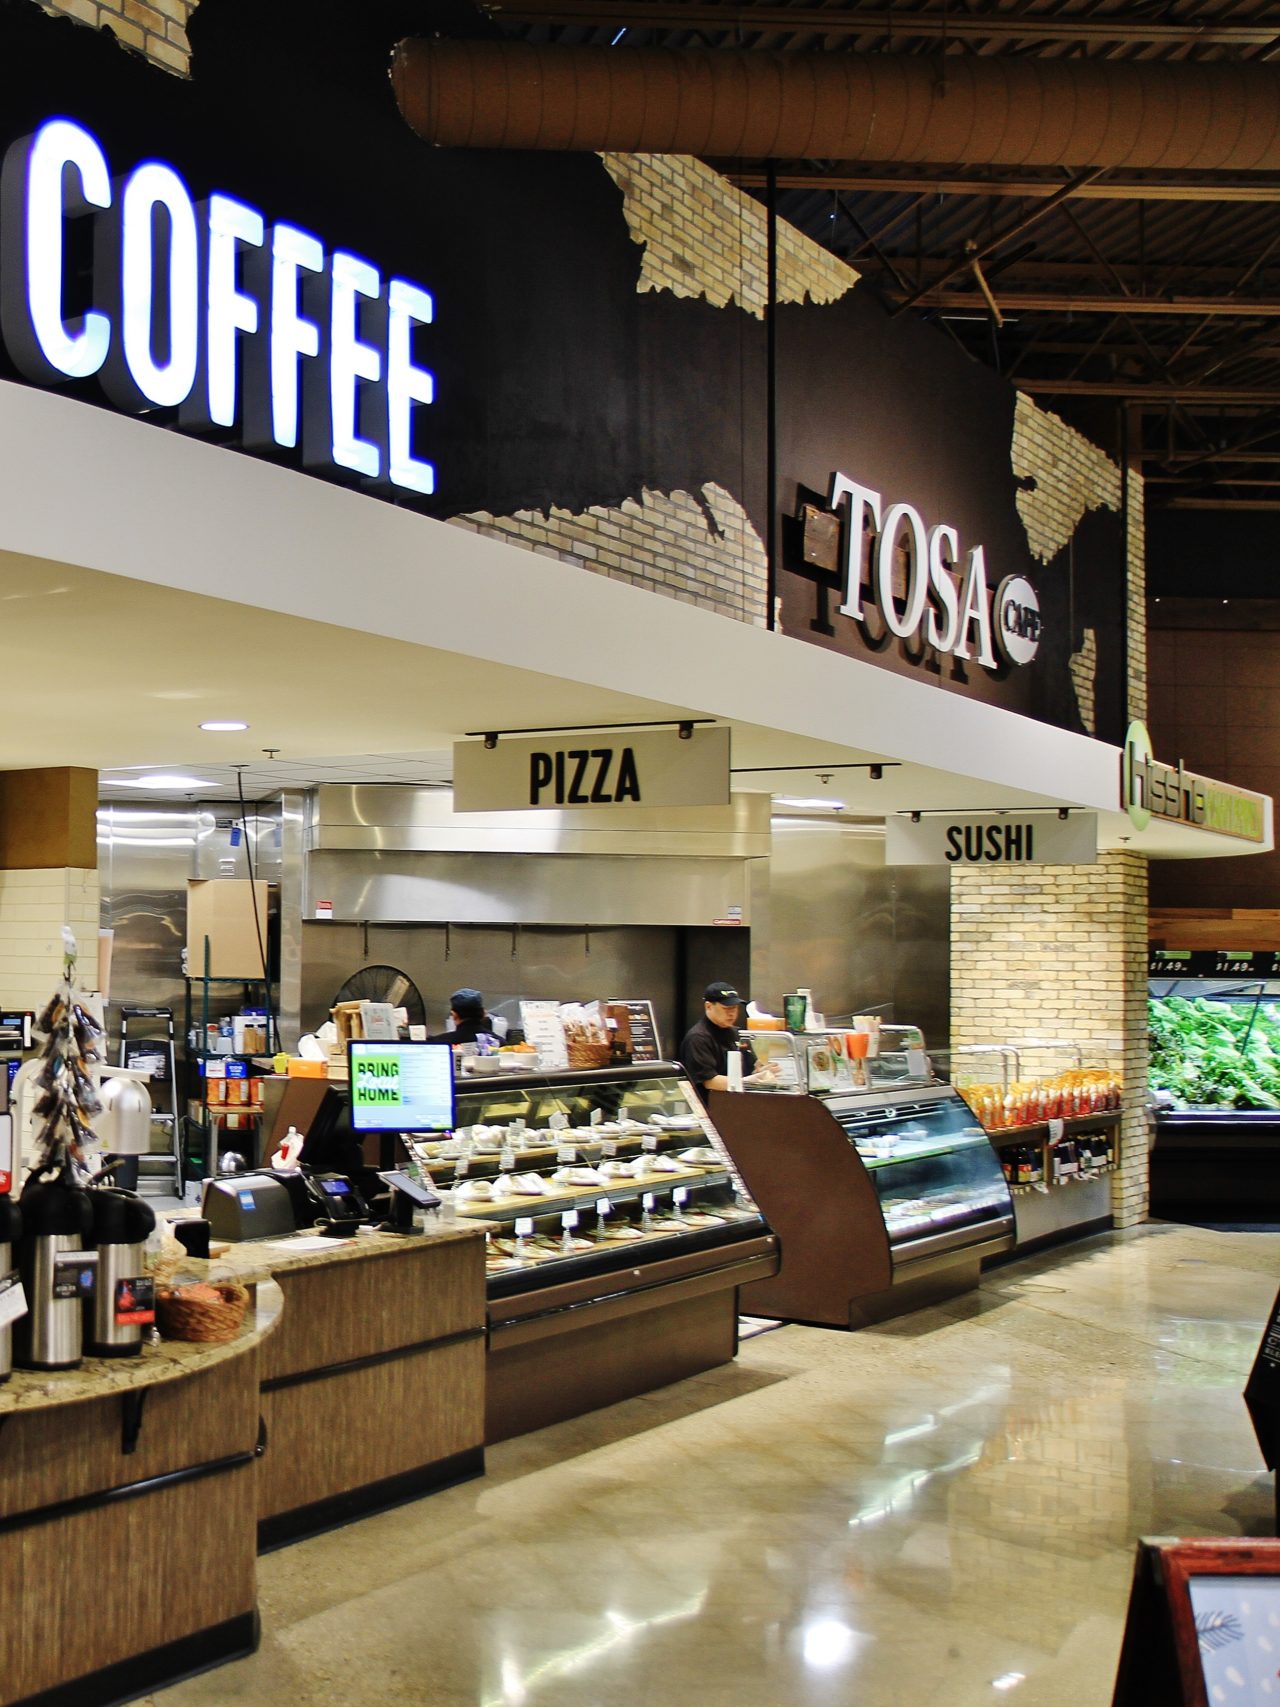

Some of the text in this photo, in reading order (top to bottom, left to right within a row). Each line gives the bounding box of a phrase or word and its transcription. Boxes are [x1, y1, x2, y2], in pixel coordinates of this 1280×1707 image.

[23, 117, 436, 495] COFFEE
[830, 471, 997, 670] TOSA
[1003, 599, 1040, 642] CAFE
[529, 748, 640, 805] PIZZA
[945, 824, 1033, 862] SUSHI
[357, 1062, 399, 1077] BRING
[357, 1087, 400, 1101] HOME
